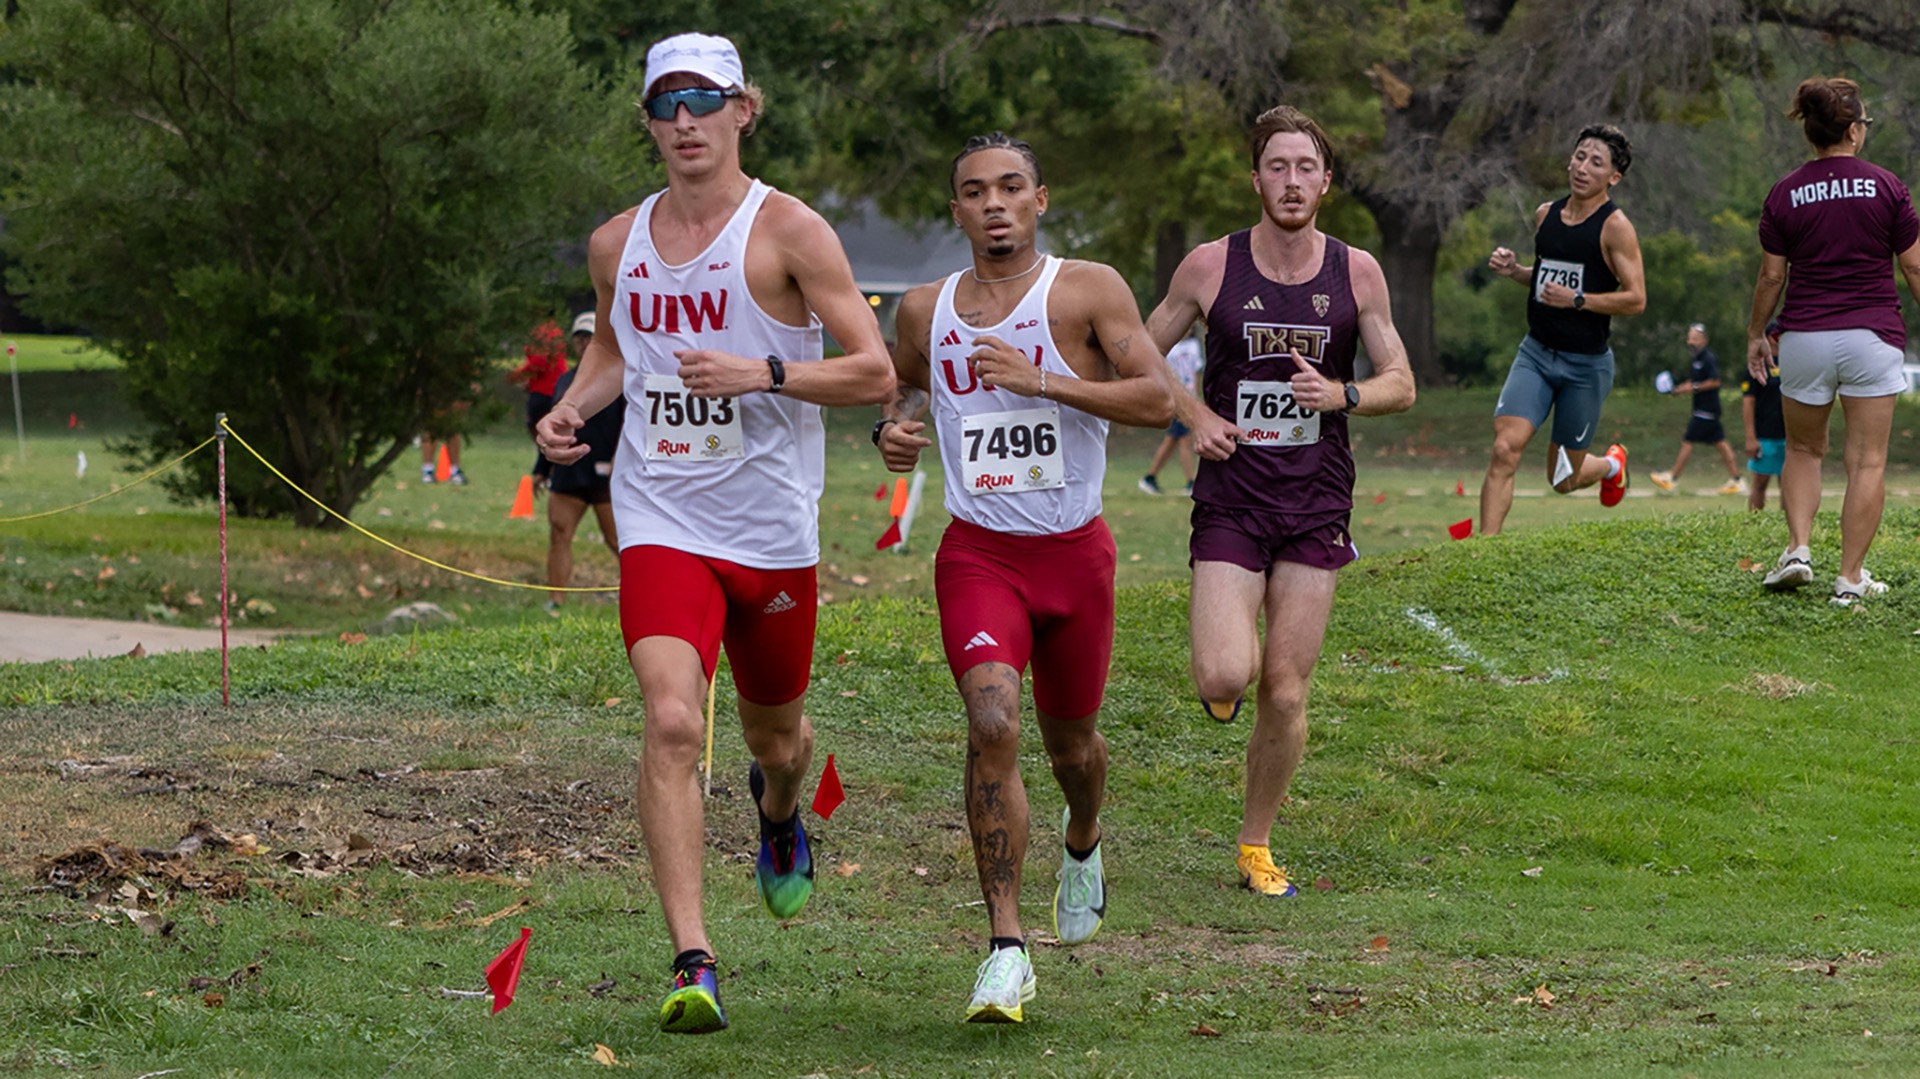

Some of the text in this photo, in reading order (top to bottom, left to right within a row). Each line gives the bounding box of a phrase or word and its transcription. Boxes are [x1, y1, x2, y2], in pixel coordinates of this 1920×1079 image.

[1790, 178, 1877, 208] MORALES
[1540, 267, 1579, 289] 7736
[629, 289, 728, 333] UIW
[1247, 326, 1327, 360] TXST
[645, 390, 734, 426] 7503
[657, 439, 690, 457] iRUN
[964, 423, 1057, 462] 7496
[975, 474, 1014, 490] iRUN
